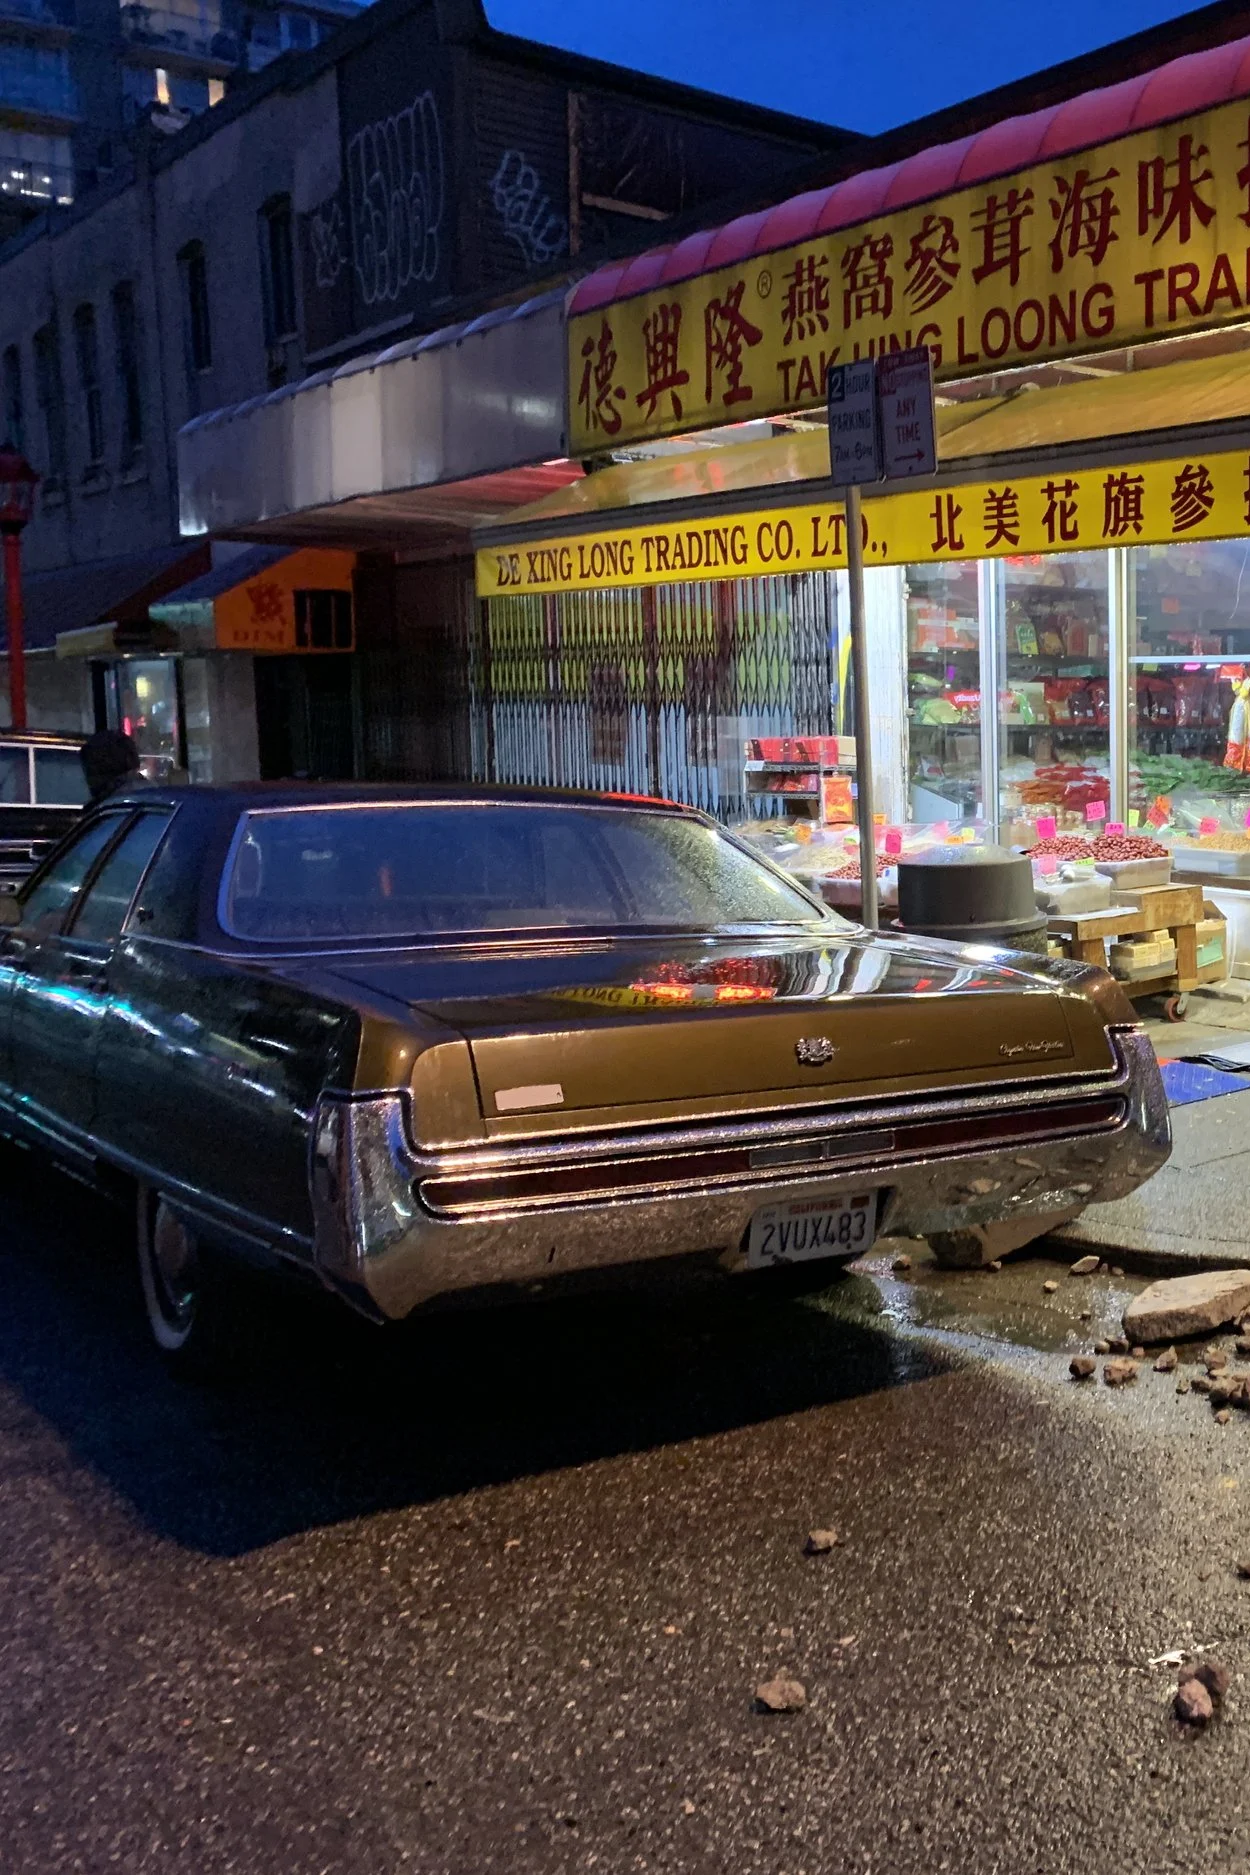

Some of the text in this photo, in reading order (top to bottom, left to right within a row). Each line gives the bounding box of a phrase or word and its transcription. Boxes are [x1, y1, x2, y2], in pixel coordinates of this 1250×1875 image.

[577, 279, 763, 436] 德興隆
[777, 346, 841, 403] TAK
[957, 282, 1115, 365] LOONG
[831, 373, 843, 399] 2
[846, 373, 870, 397] HOUR
[832, 408, 871, 432] PARKING
[896, 396, 916, 418] ANY
[895, 421, 921, 444] TIME
[496, 553, 521, 586] DE
[527, 547, 573, 584] XING
[577, 539, 635, 579] LONG
[641, 525, 749, 572] TRADING
[757, 519, 801, 563] CO.
[761, 1211, 866, 1256] 2VUX483
